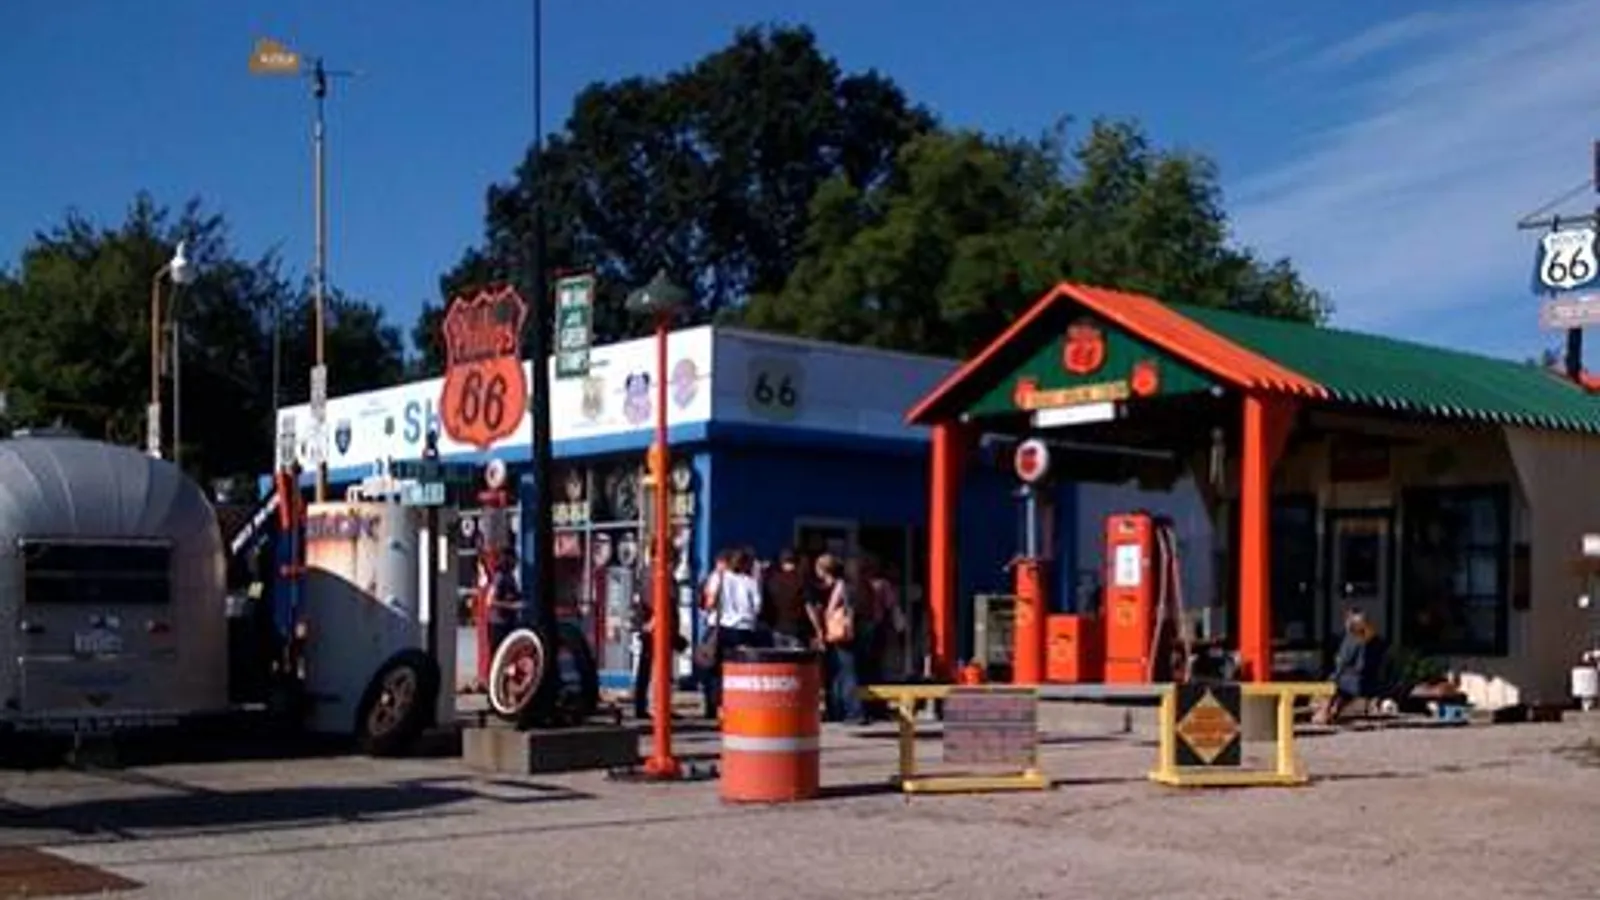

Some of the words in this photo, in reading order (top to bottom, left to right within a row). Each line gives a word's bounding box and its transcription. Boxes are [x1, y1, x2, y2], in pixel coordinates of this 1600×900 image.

[1547, 246, 1590, 283] 66
[460, 370, 508, 432] 66
[754, 370, 797, 409] 66
